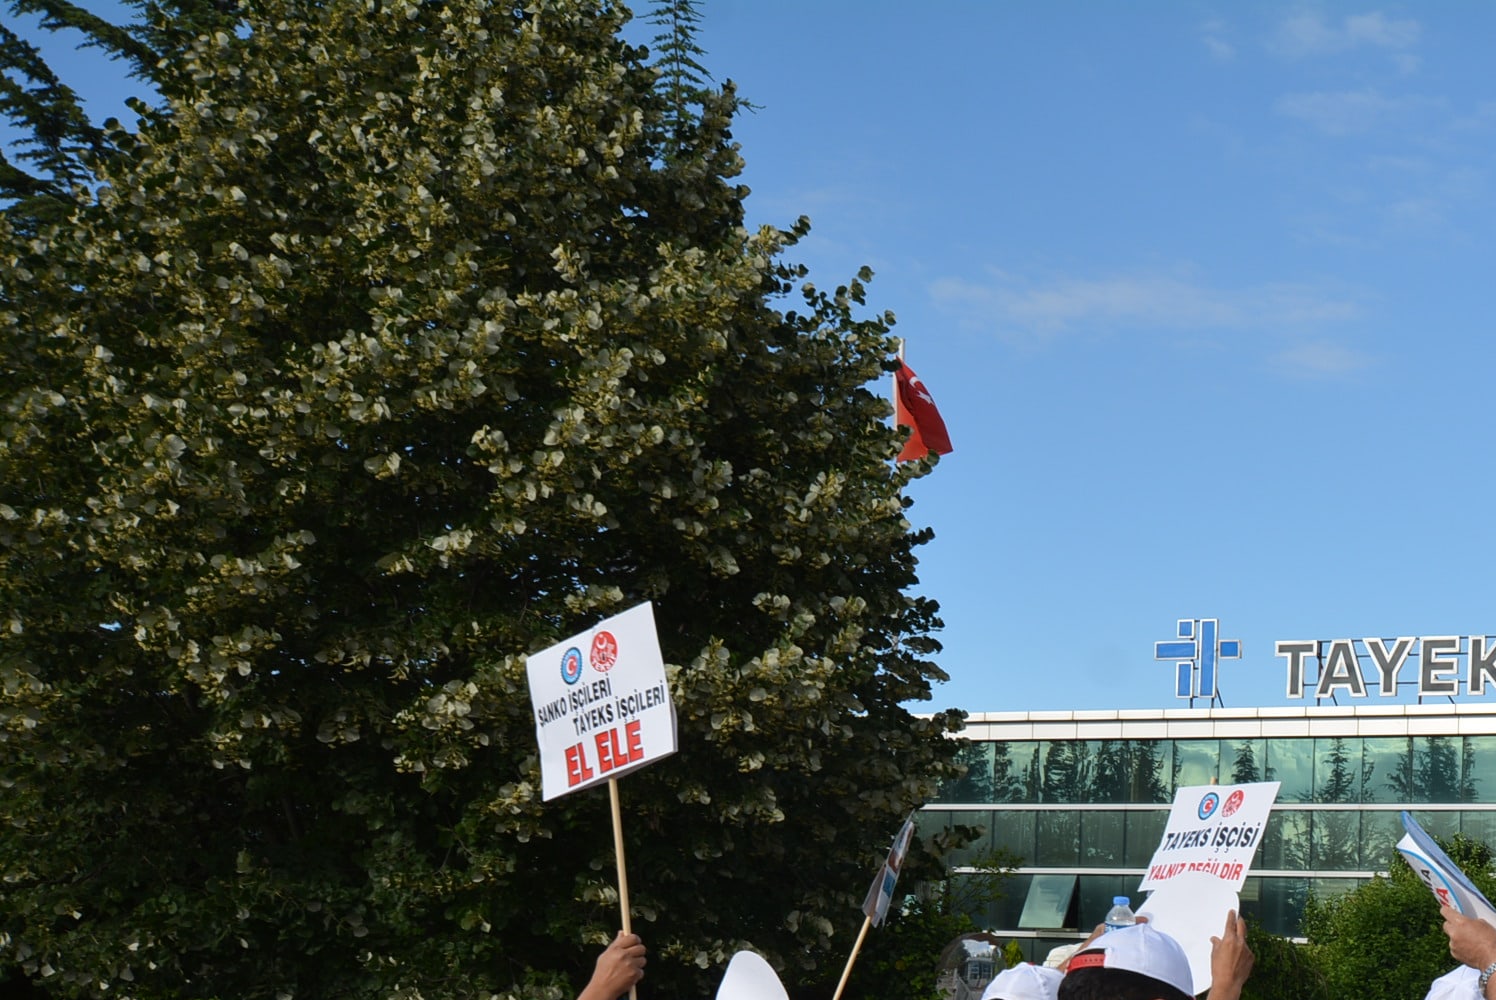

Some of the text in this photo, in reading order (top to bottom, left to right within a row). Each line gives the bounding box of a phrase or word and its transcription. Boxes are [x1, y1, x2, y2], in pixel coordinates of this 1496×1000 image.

[538, 699, 568, 727] SANKO
[573, 680, 666, 736] TAYEKS İŞÇİLERİ
[564, 719, 644, 788] EL ELE
[1162, 822, 1261, 853] TAYEKS İŞÇİSİ
